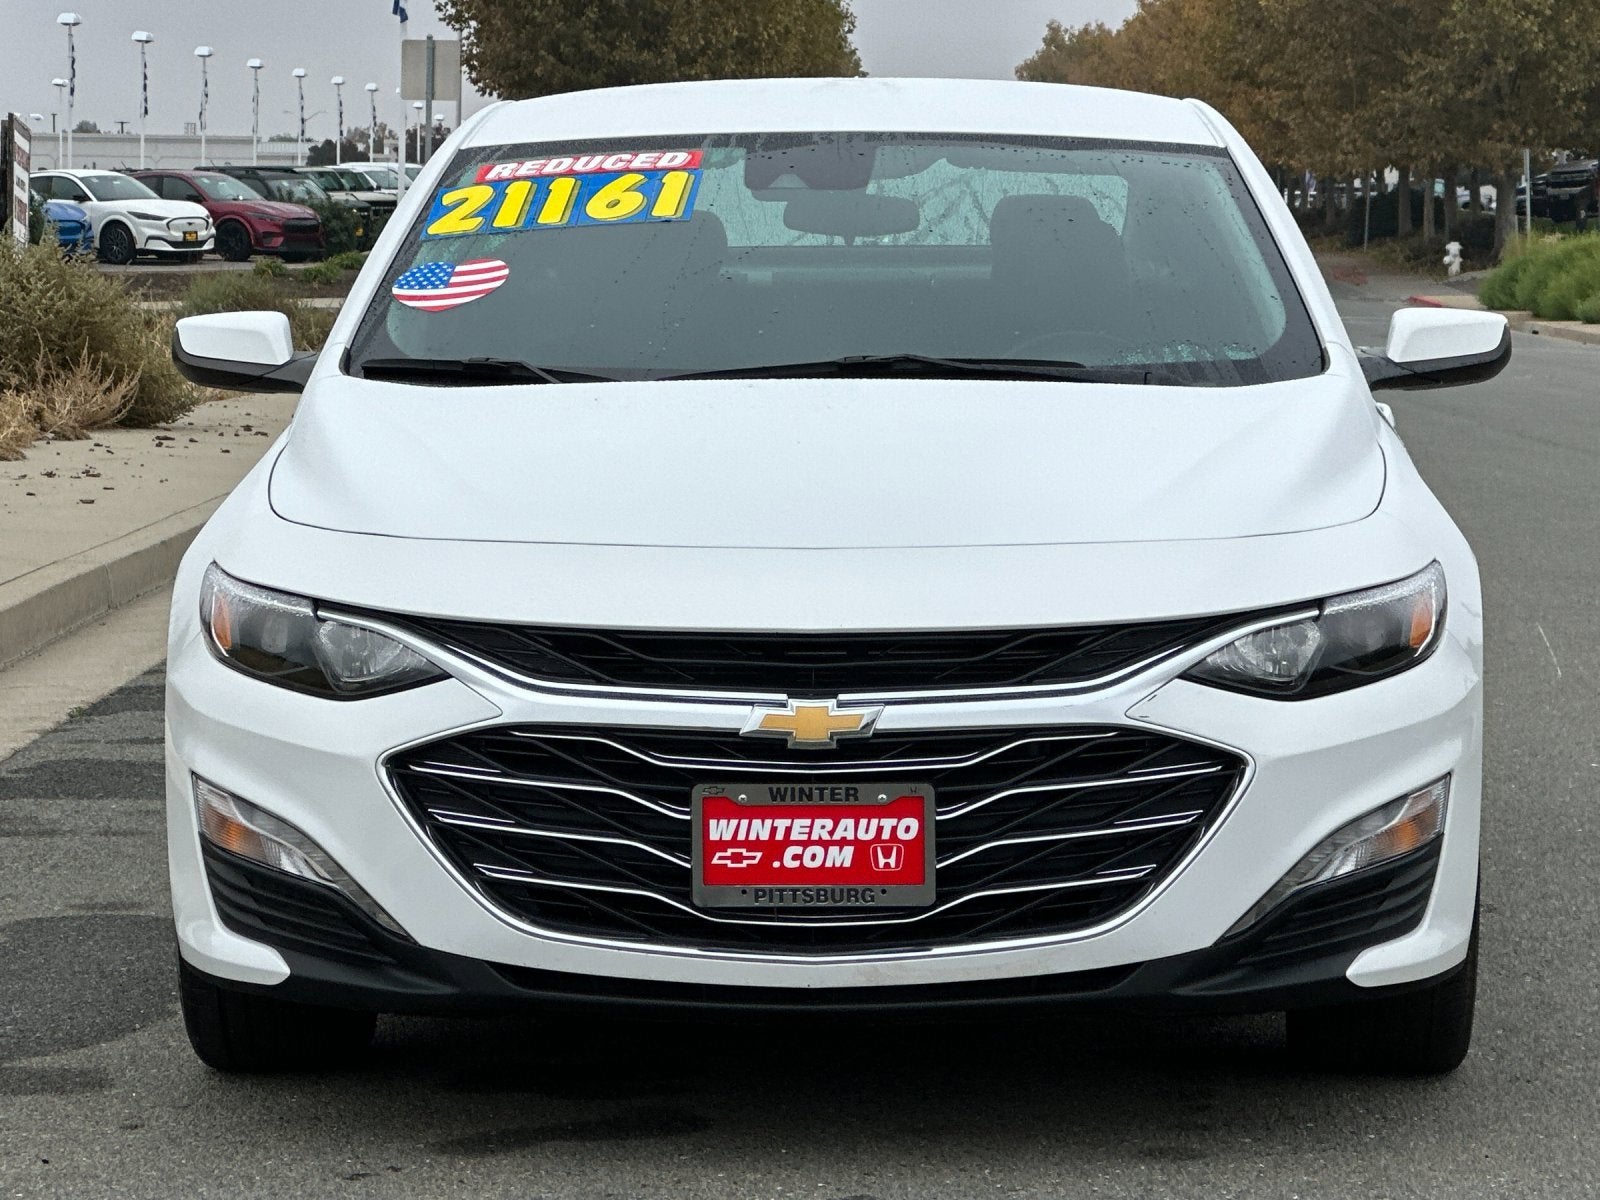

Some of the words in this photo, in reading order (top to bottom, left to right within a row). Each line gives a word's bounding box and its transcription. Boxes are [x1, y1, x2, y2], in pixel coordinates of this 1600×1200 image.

[485, 151, 691, 180] REDUCED
[427, 171, 694, 235] 21161
[768, 787, 860, 803] WINTER
[708, 817, 919, 841] WINTERAUTO
[772, 845, 854, 869] .COM
[753, 888, 876, 904] PITTSBURG
